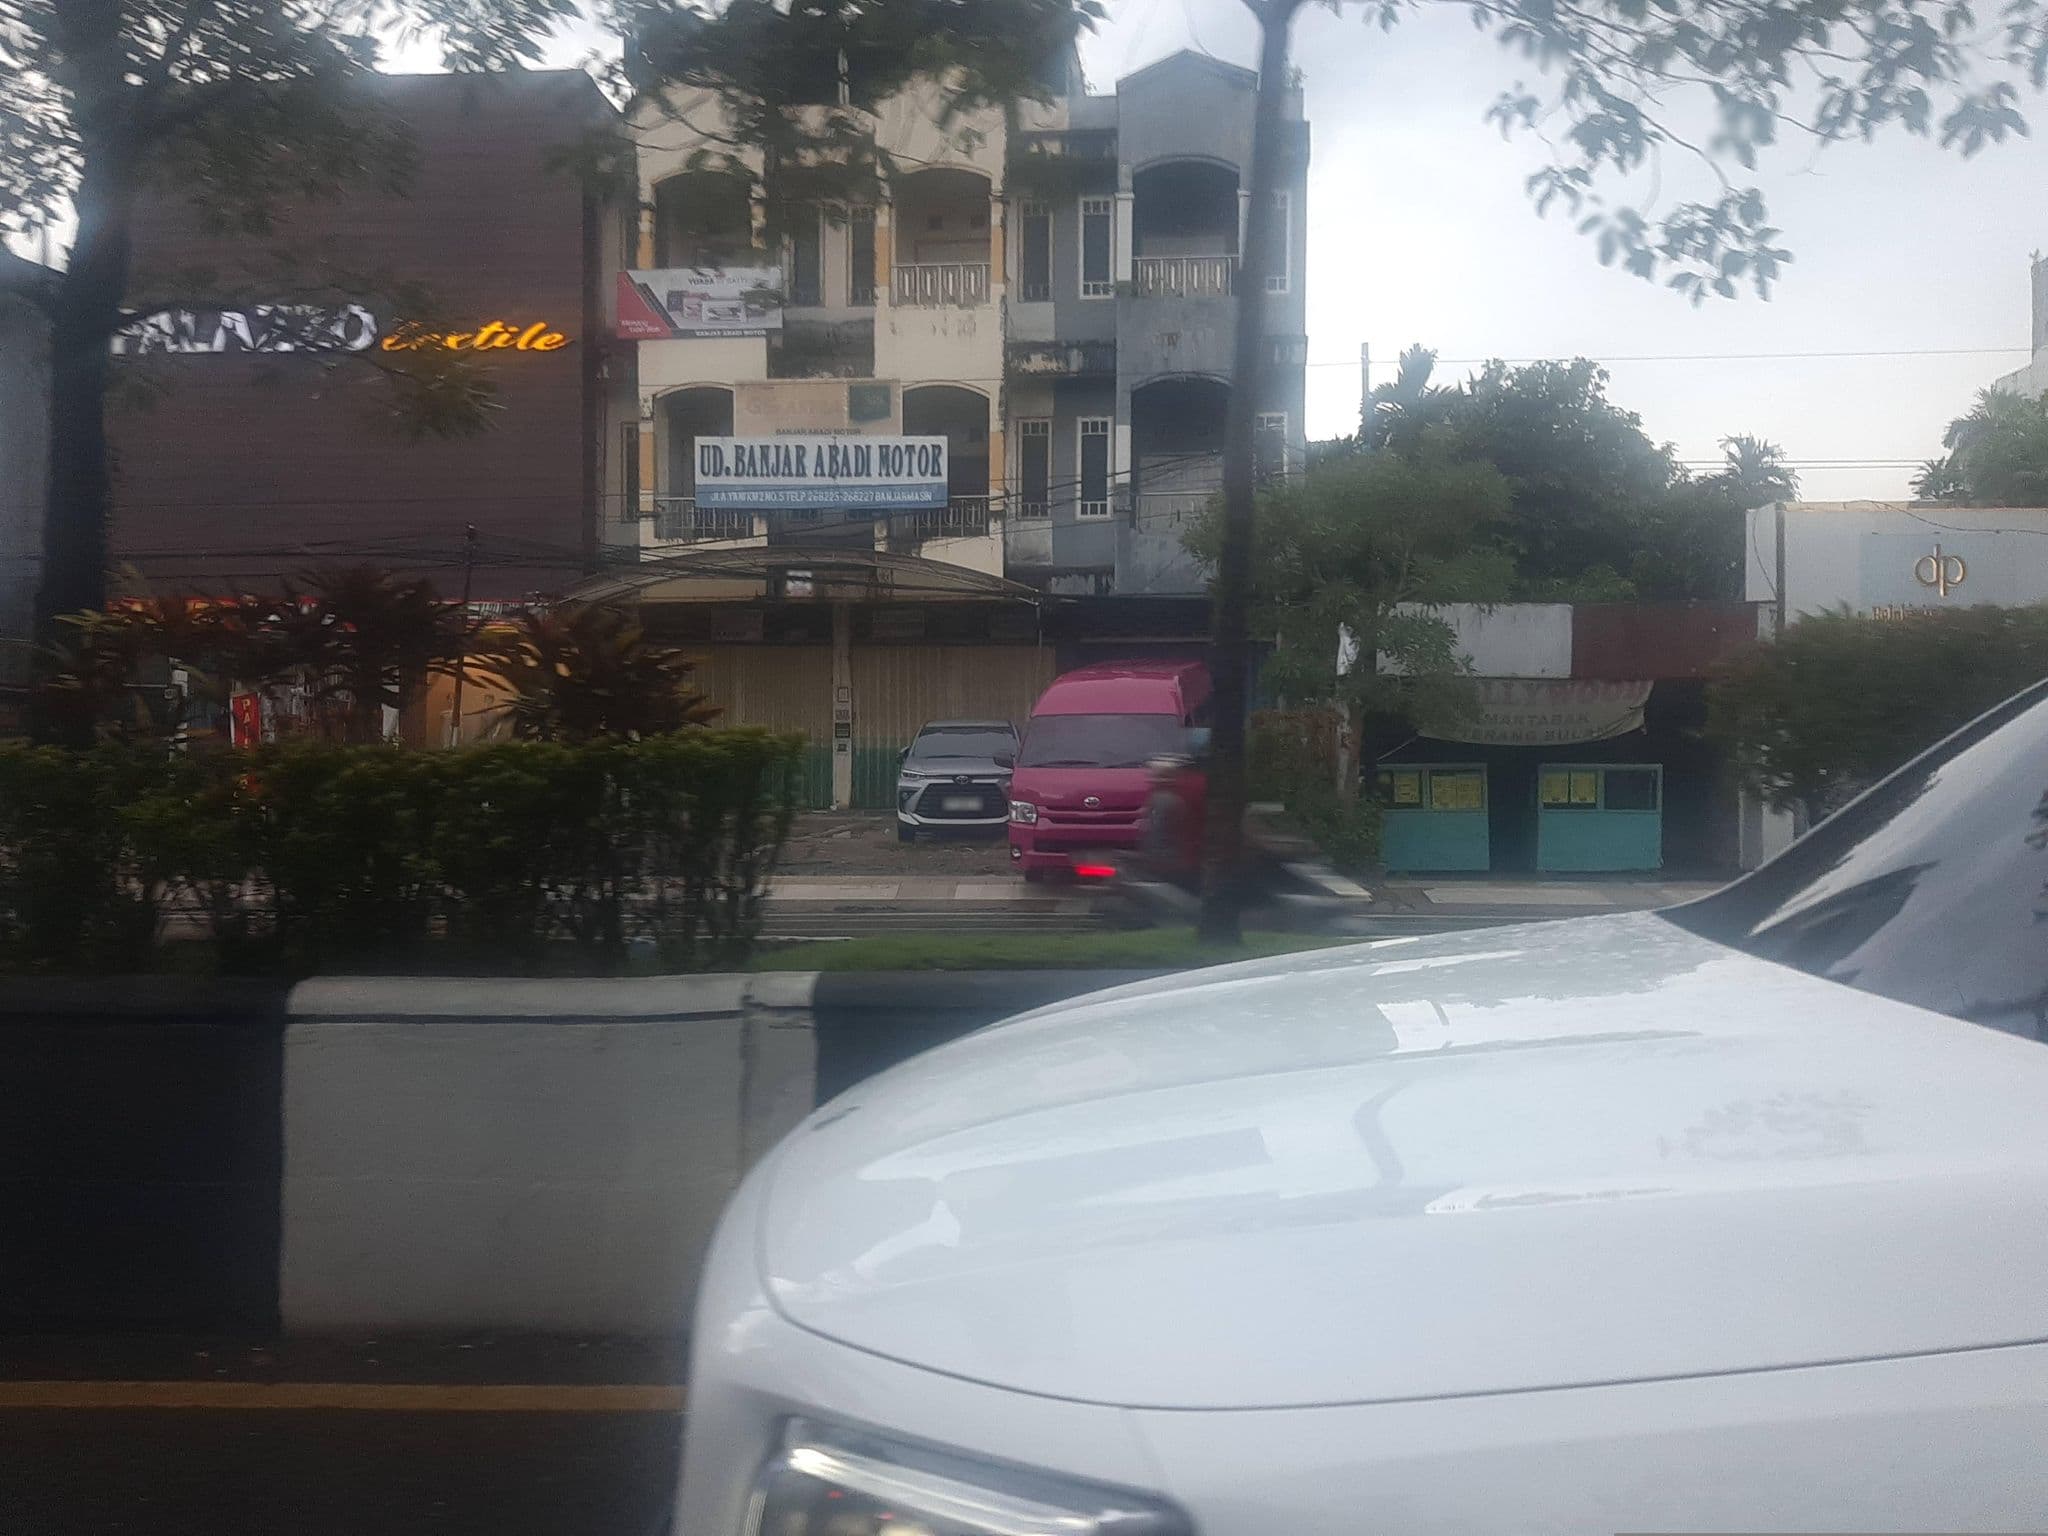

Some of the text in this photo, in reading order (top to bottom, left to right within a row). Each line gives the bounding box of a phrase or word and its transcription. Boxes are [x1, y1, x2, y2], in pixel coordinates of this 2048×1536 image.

[833, 427, 862, 437] MOTOR
[813, 444, 872, 477] ABADI
[878, 443, 942, 477] MOTOR
[1484, 713, 1591, 726] MARTABAK
